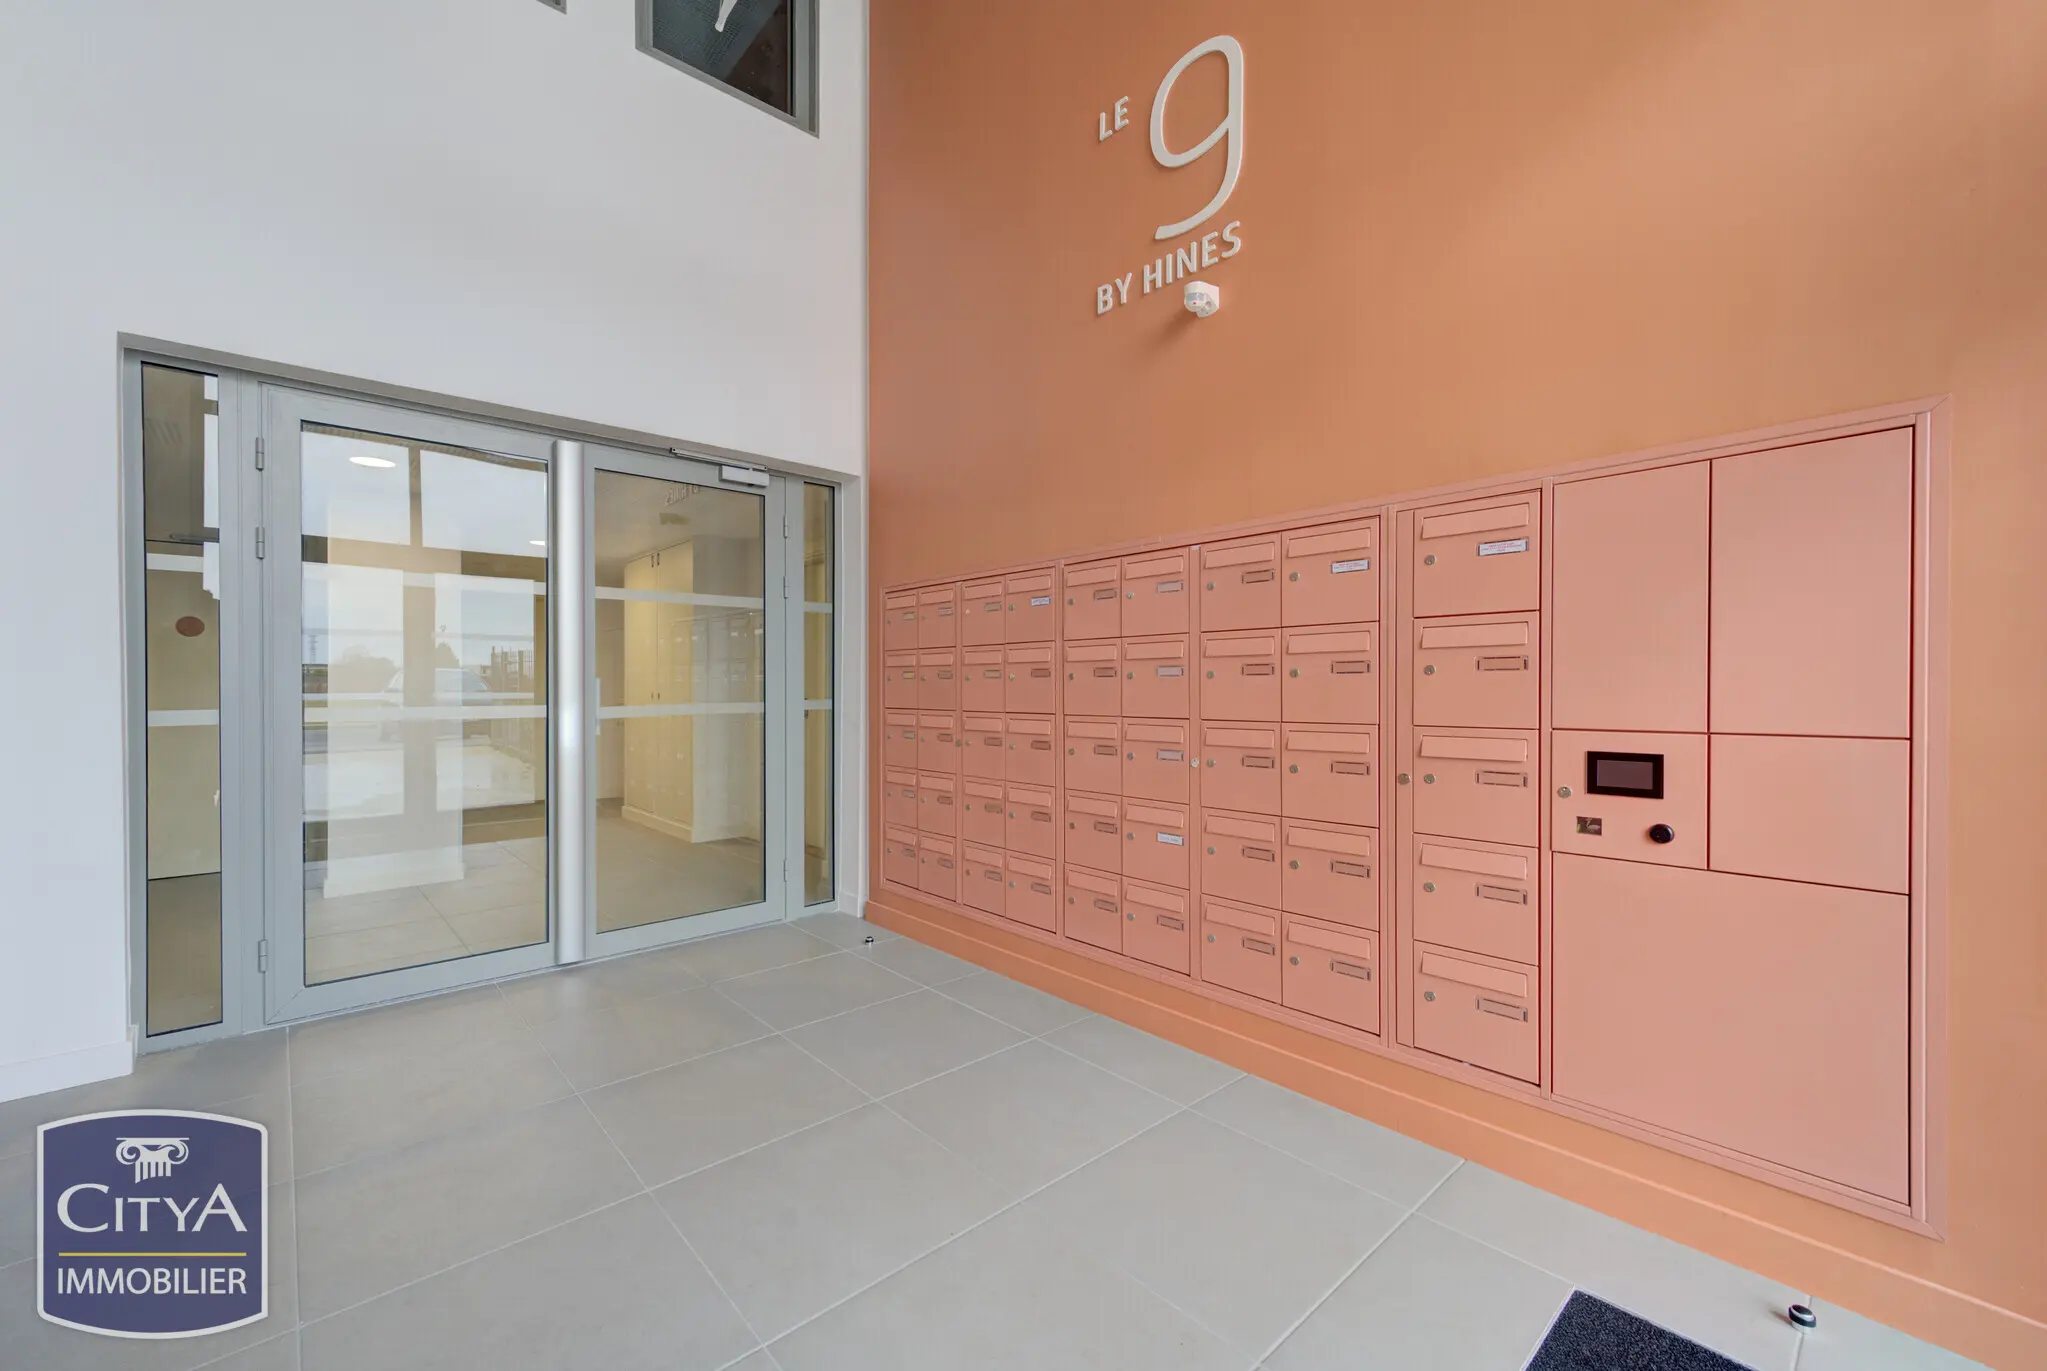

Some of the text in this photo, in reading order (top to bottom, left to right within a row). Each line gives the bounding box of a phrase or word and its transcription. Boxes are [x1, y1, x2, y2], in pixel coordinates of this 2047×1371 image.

[1099, 34, 1244, 240] LE 9
[1097, 220, 1243, 315] BY HINES
